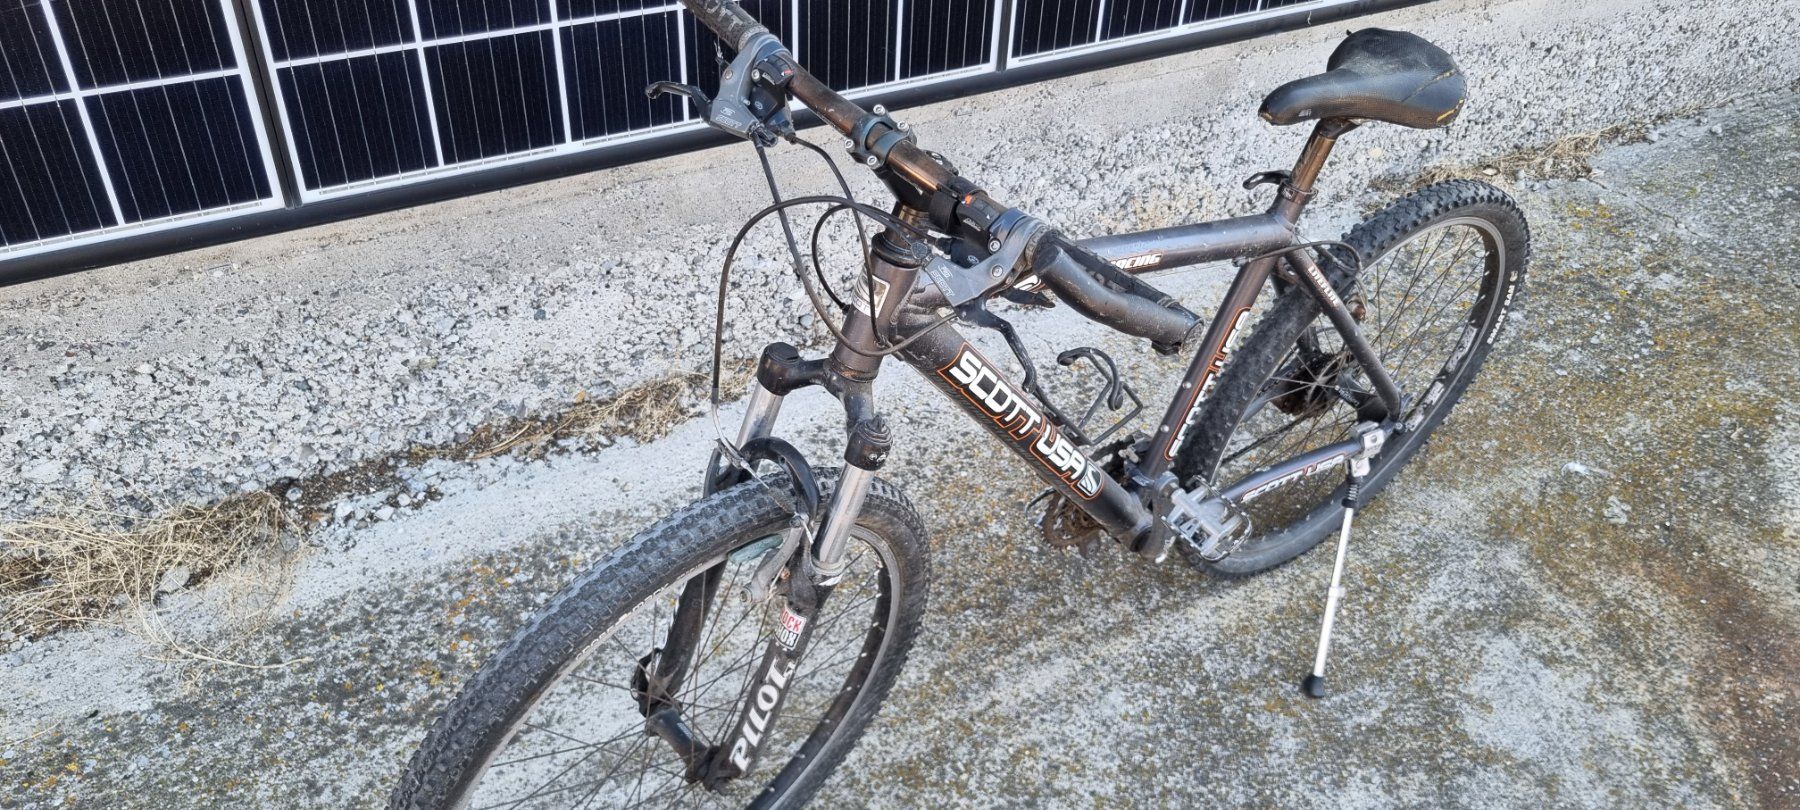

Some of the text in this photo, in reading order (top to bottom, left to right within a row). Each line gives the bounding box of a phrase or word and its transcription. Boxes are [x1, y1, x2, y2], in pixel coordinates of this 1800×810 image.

[1110, 253, 1163, 269] ACING
[1486, 284, 1516, 345] SMART SAM
[949, 350, 1086, 480] SCOTT USA
[728, 656, 788, 773] PILOT
